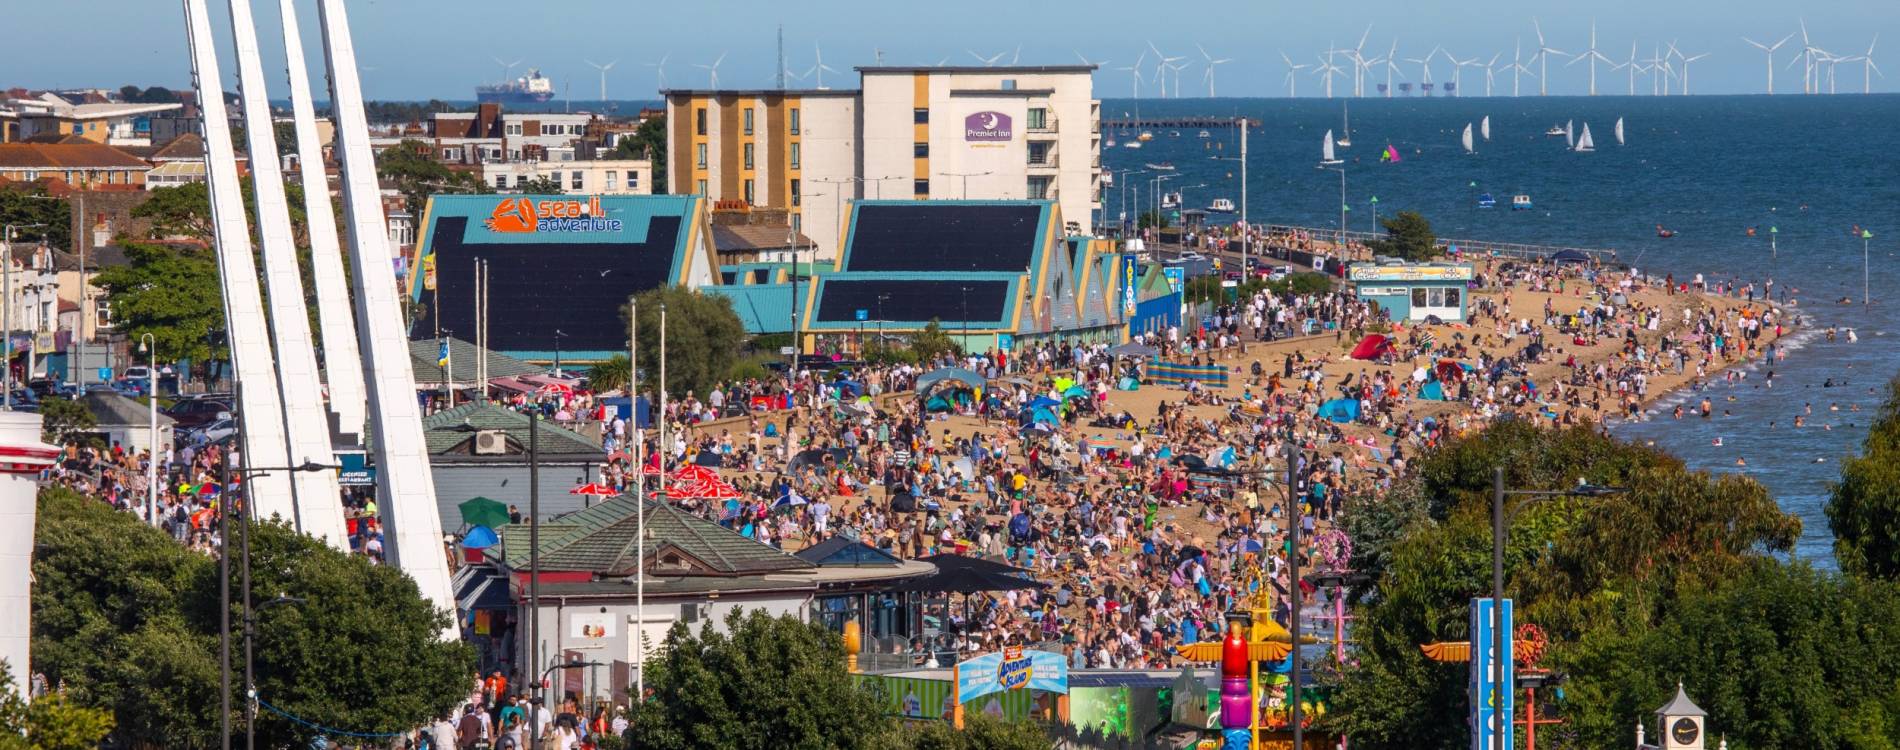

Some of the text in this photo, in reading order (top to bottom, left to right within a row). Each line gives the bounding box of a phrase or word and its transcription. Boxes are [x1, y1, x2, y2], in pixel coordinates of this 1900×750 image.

[967, 129, 1010, 137] Premier Inn
[538, 218, 621, 232] adventure
[1000, 656, 1033, 678] ADVENTURE
[1006, 671, 1027, 690] ISLAND
